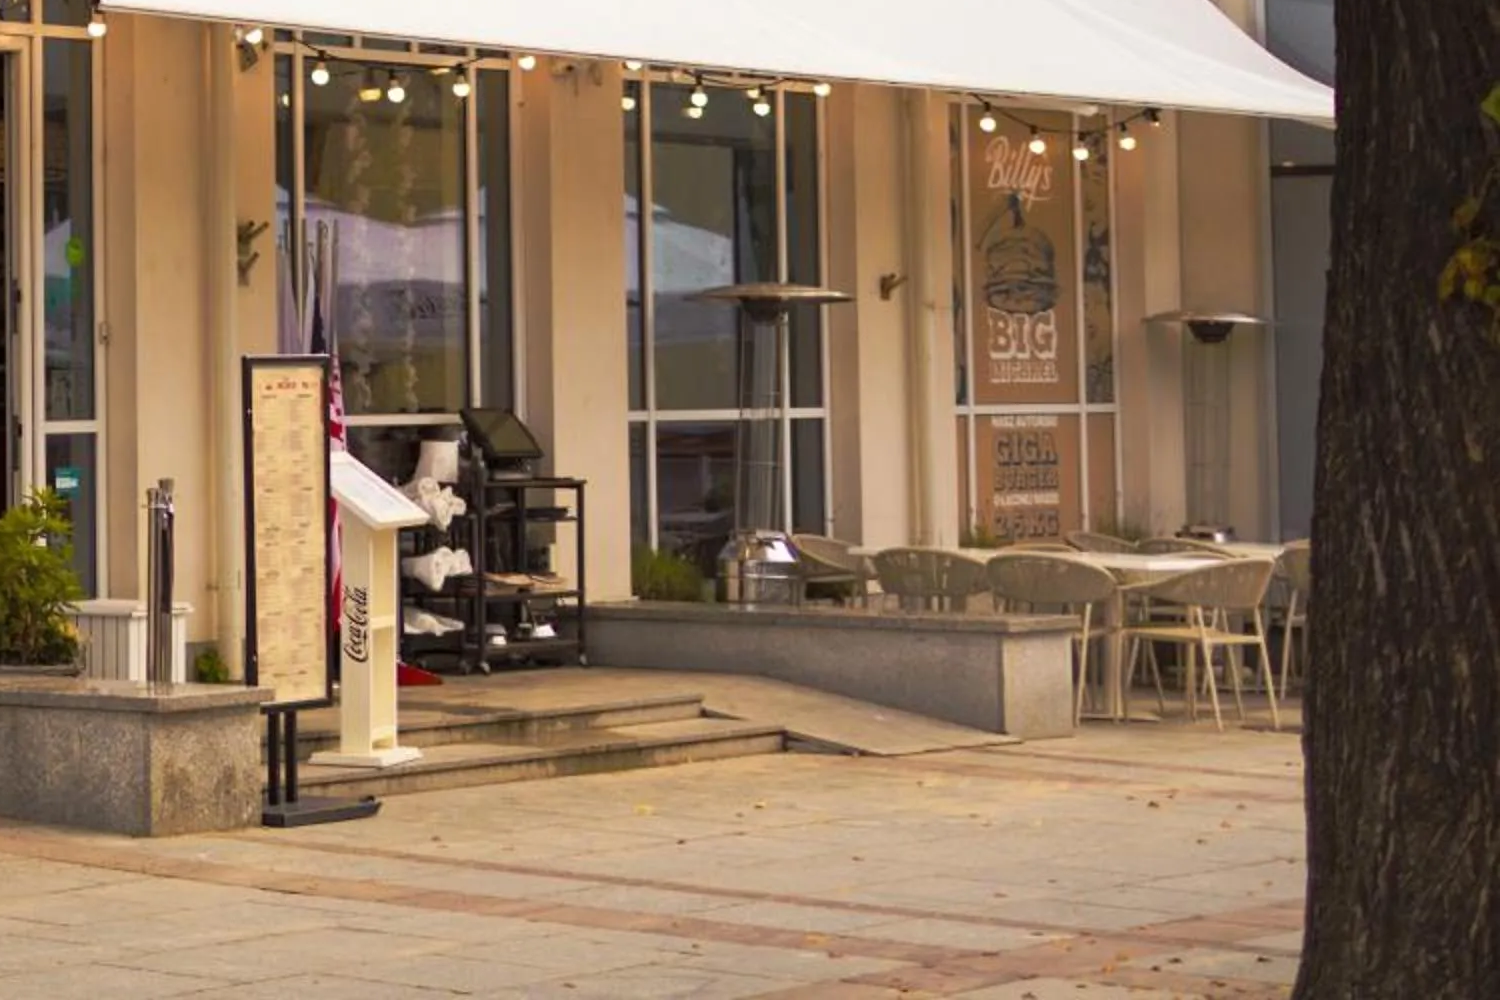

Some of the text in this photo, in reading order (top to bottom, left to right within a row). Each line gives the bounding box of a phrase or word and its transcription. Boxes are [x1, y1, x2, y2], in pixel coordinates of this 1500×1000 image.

[984, 135, 1053, 212] Billy's
[987, 307, 1058, 360] BIG
[995, 431, 1059, 466] GIGA
[994, 467, 1059, 491] BURGER
